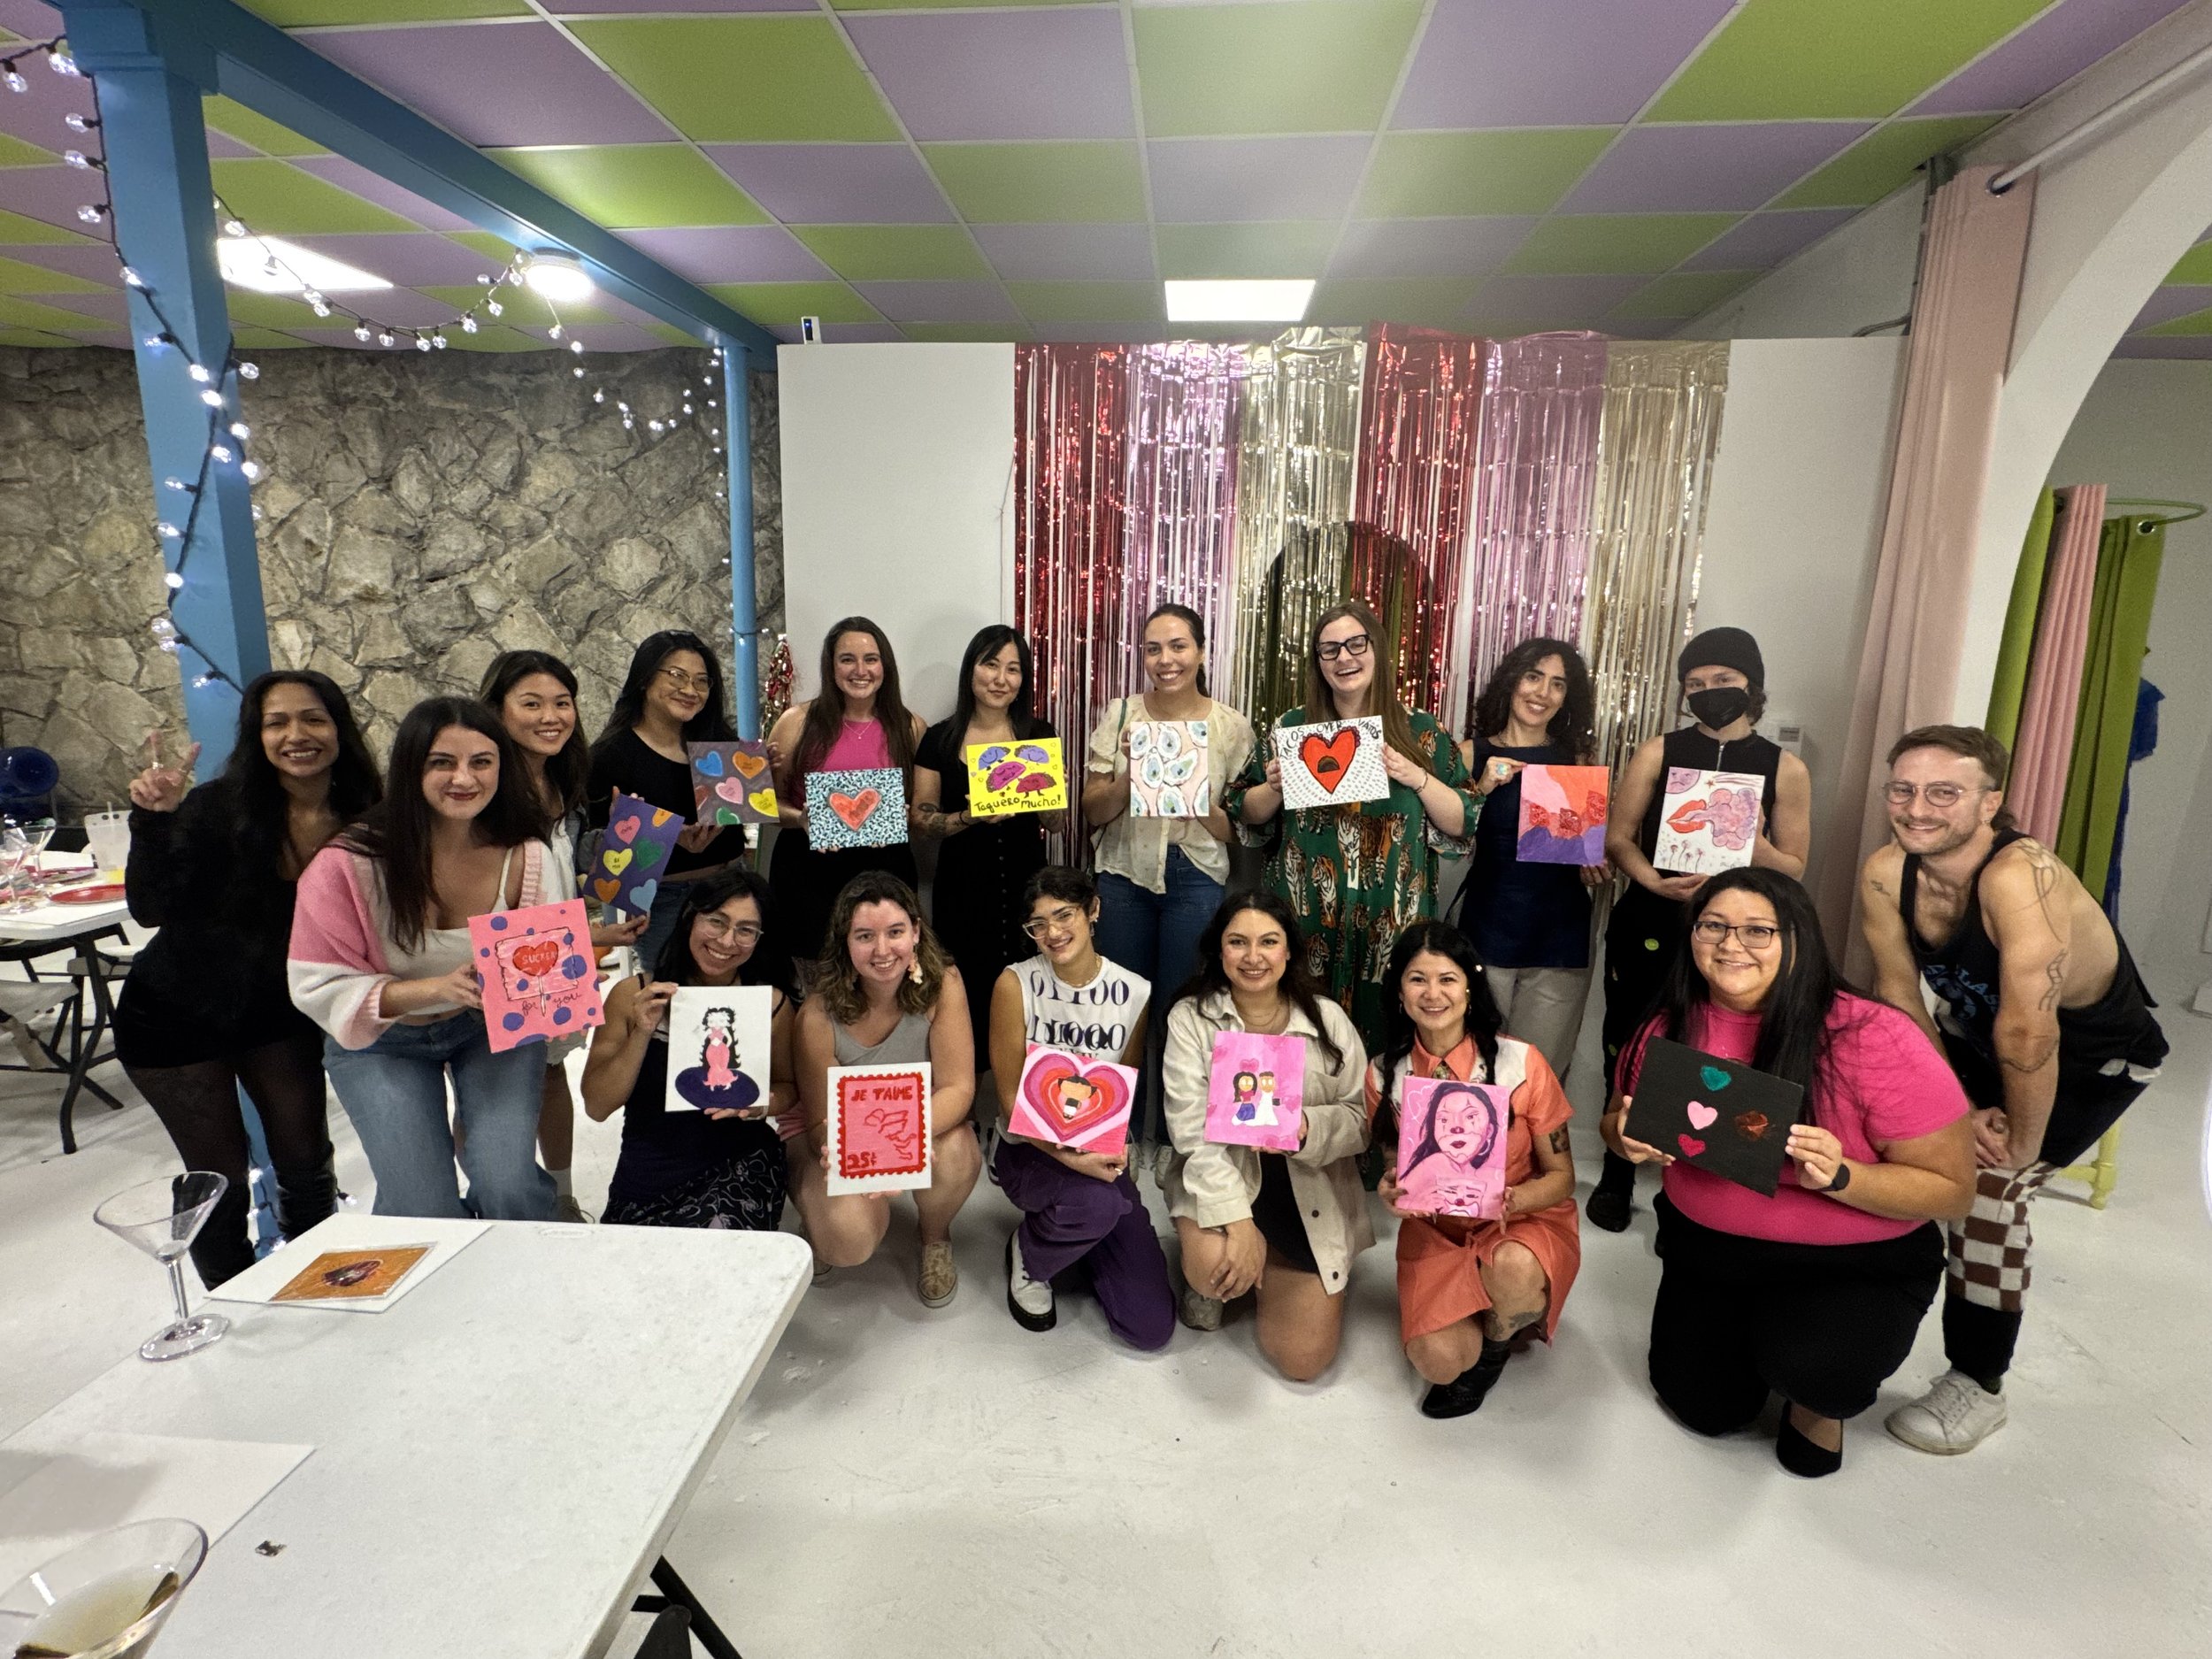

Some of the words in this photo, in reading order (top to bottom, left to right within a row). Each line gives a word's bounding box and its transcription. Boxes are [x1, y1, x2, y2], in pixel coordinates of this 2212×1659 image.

[1279, 727, 1304, 760] TACOS
[1317, 721, 1342, 733] OVER
[1358, 718, 1382, 740] VATOS
[522, 951, 556, 964] SUCKER
[553, 992, 583, 1009] you
[850, 1089, 867, 1102] JE
